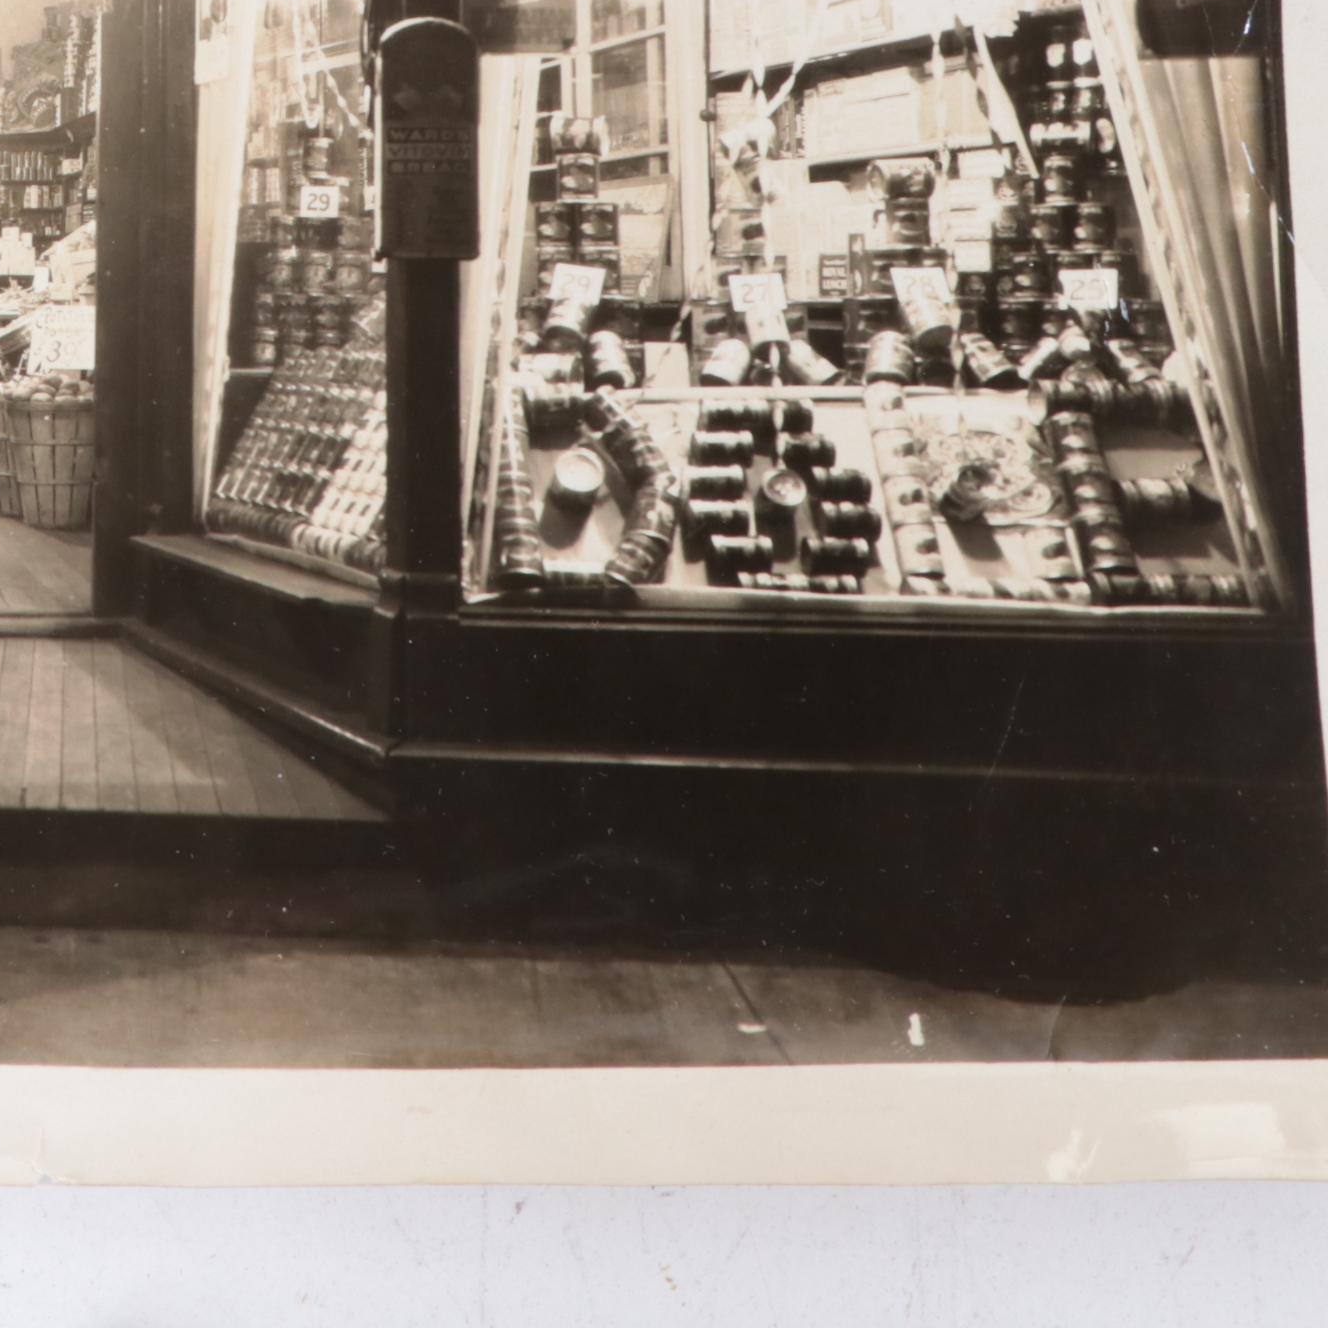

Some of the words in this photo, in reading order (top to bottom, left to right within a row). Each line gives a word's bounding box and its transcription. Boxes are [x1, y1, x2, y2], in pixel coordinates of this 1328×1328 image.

[307, 192, 331, 212] 29
[561, 272, 592, 294] 29
[740, 282, 769, 304] 27
